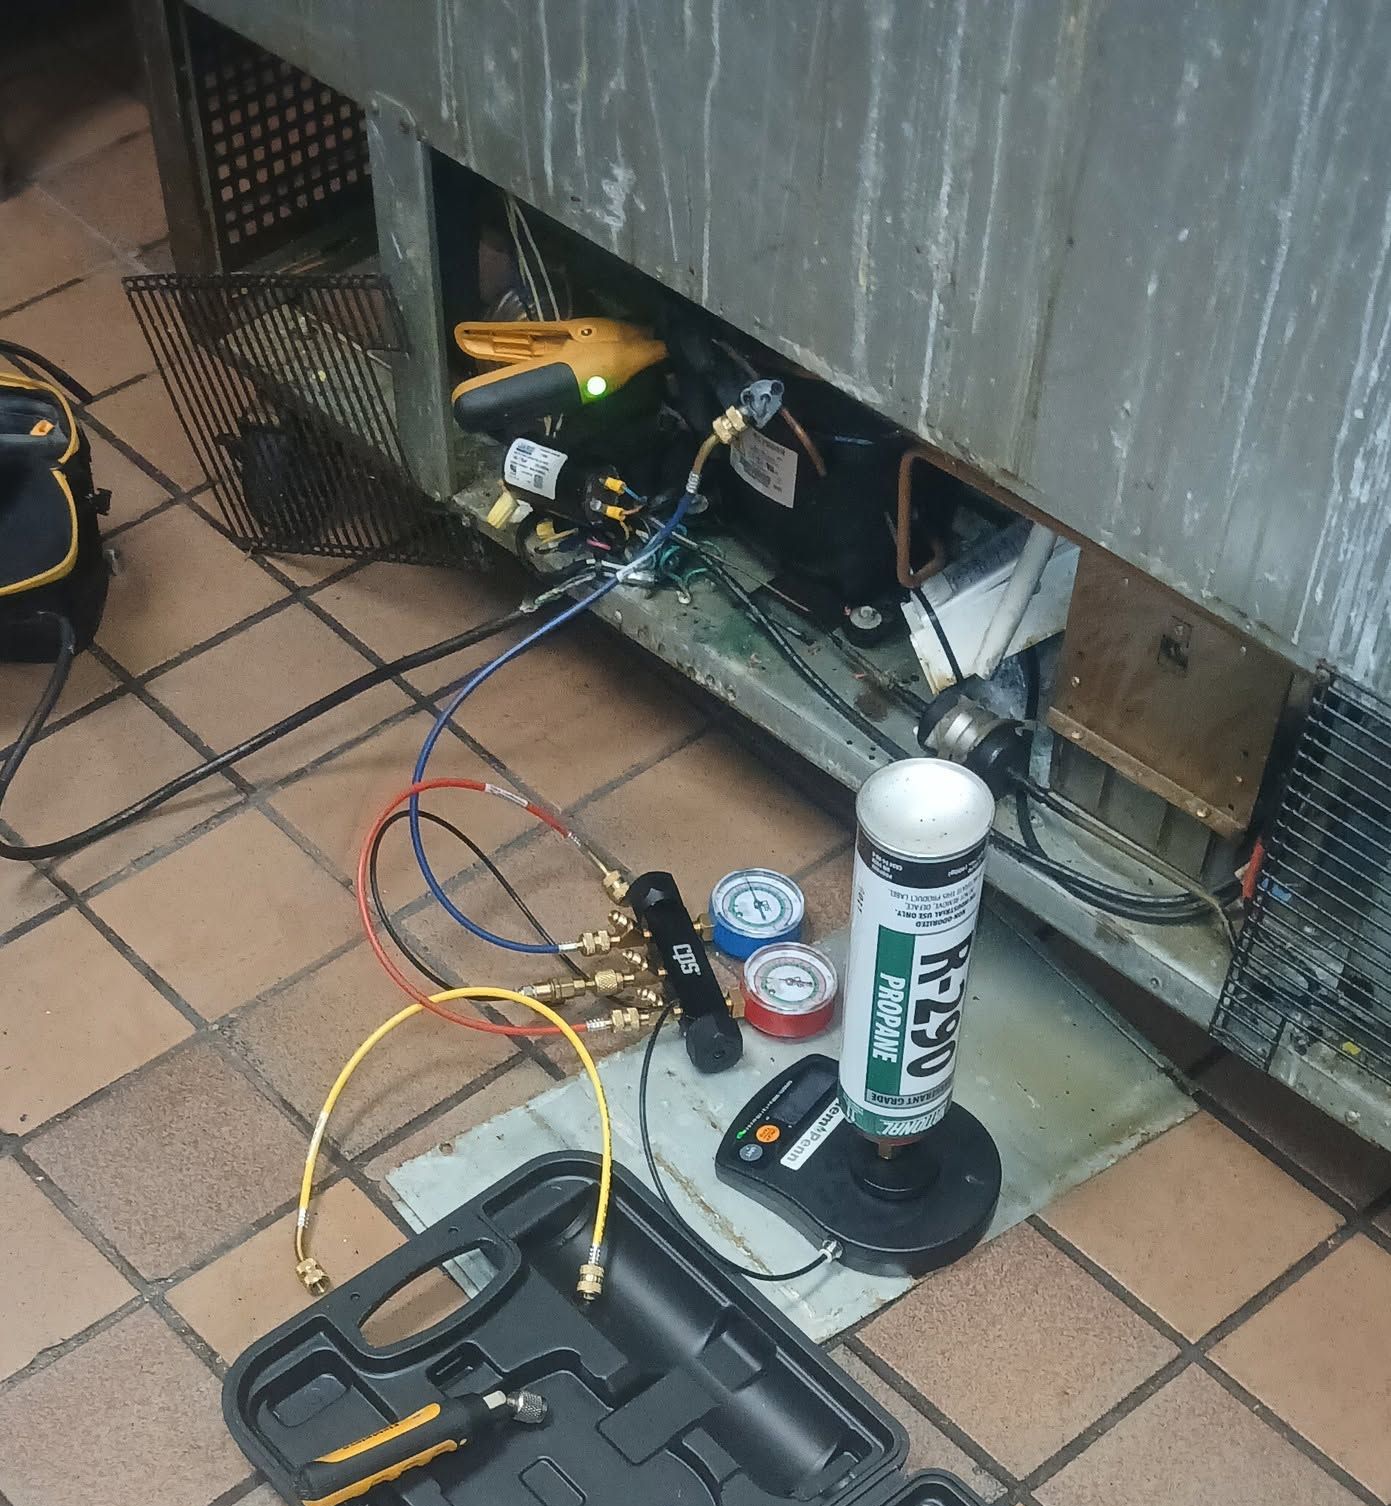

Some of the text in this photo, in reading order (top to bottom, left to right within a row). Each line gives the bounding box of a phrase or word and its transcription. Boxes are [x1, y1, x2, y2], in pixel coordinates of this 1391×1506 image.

[895, 909, 917, 920] ONLY.
[915, 909, 966, 927] NON-ODORIZED
[919, 912, 933, 920] USE
[906, 929, 974, 1078] R-290
[872, 972, 905, 1063] PROPANE
[871, 1093, 904, 1106] GRADE
